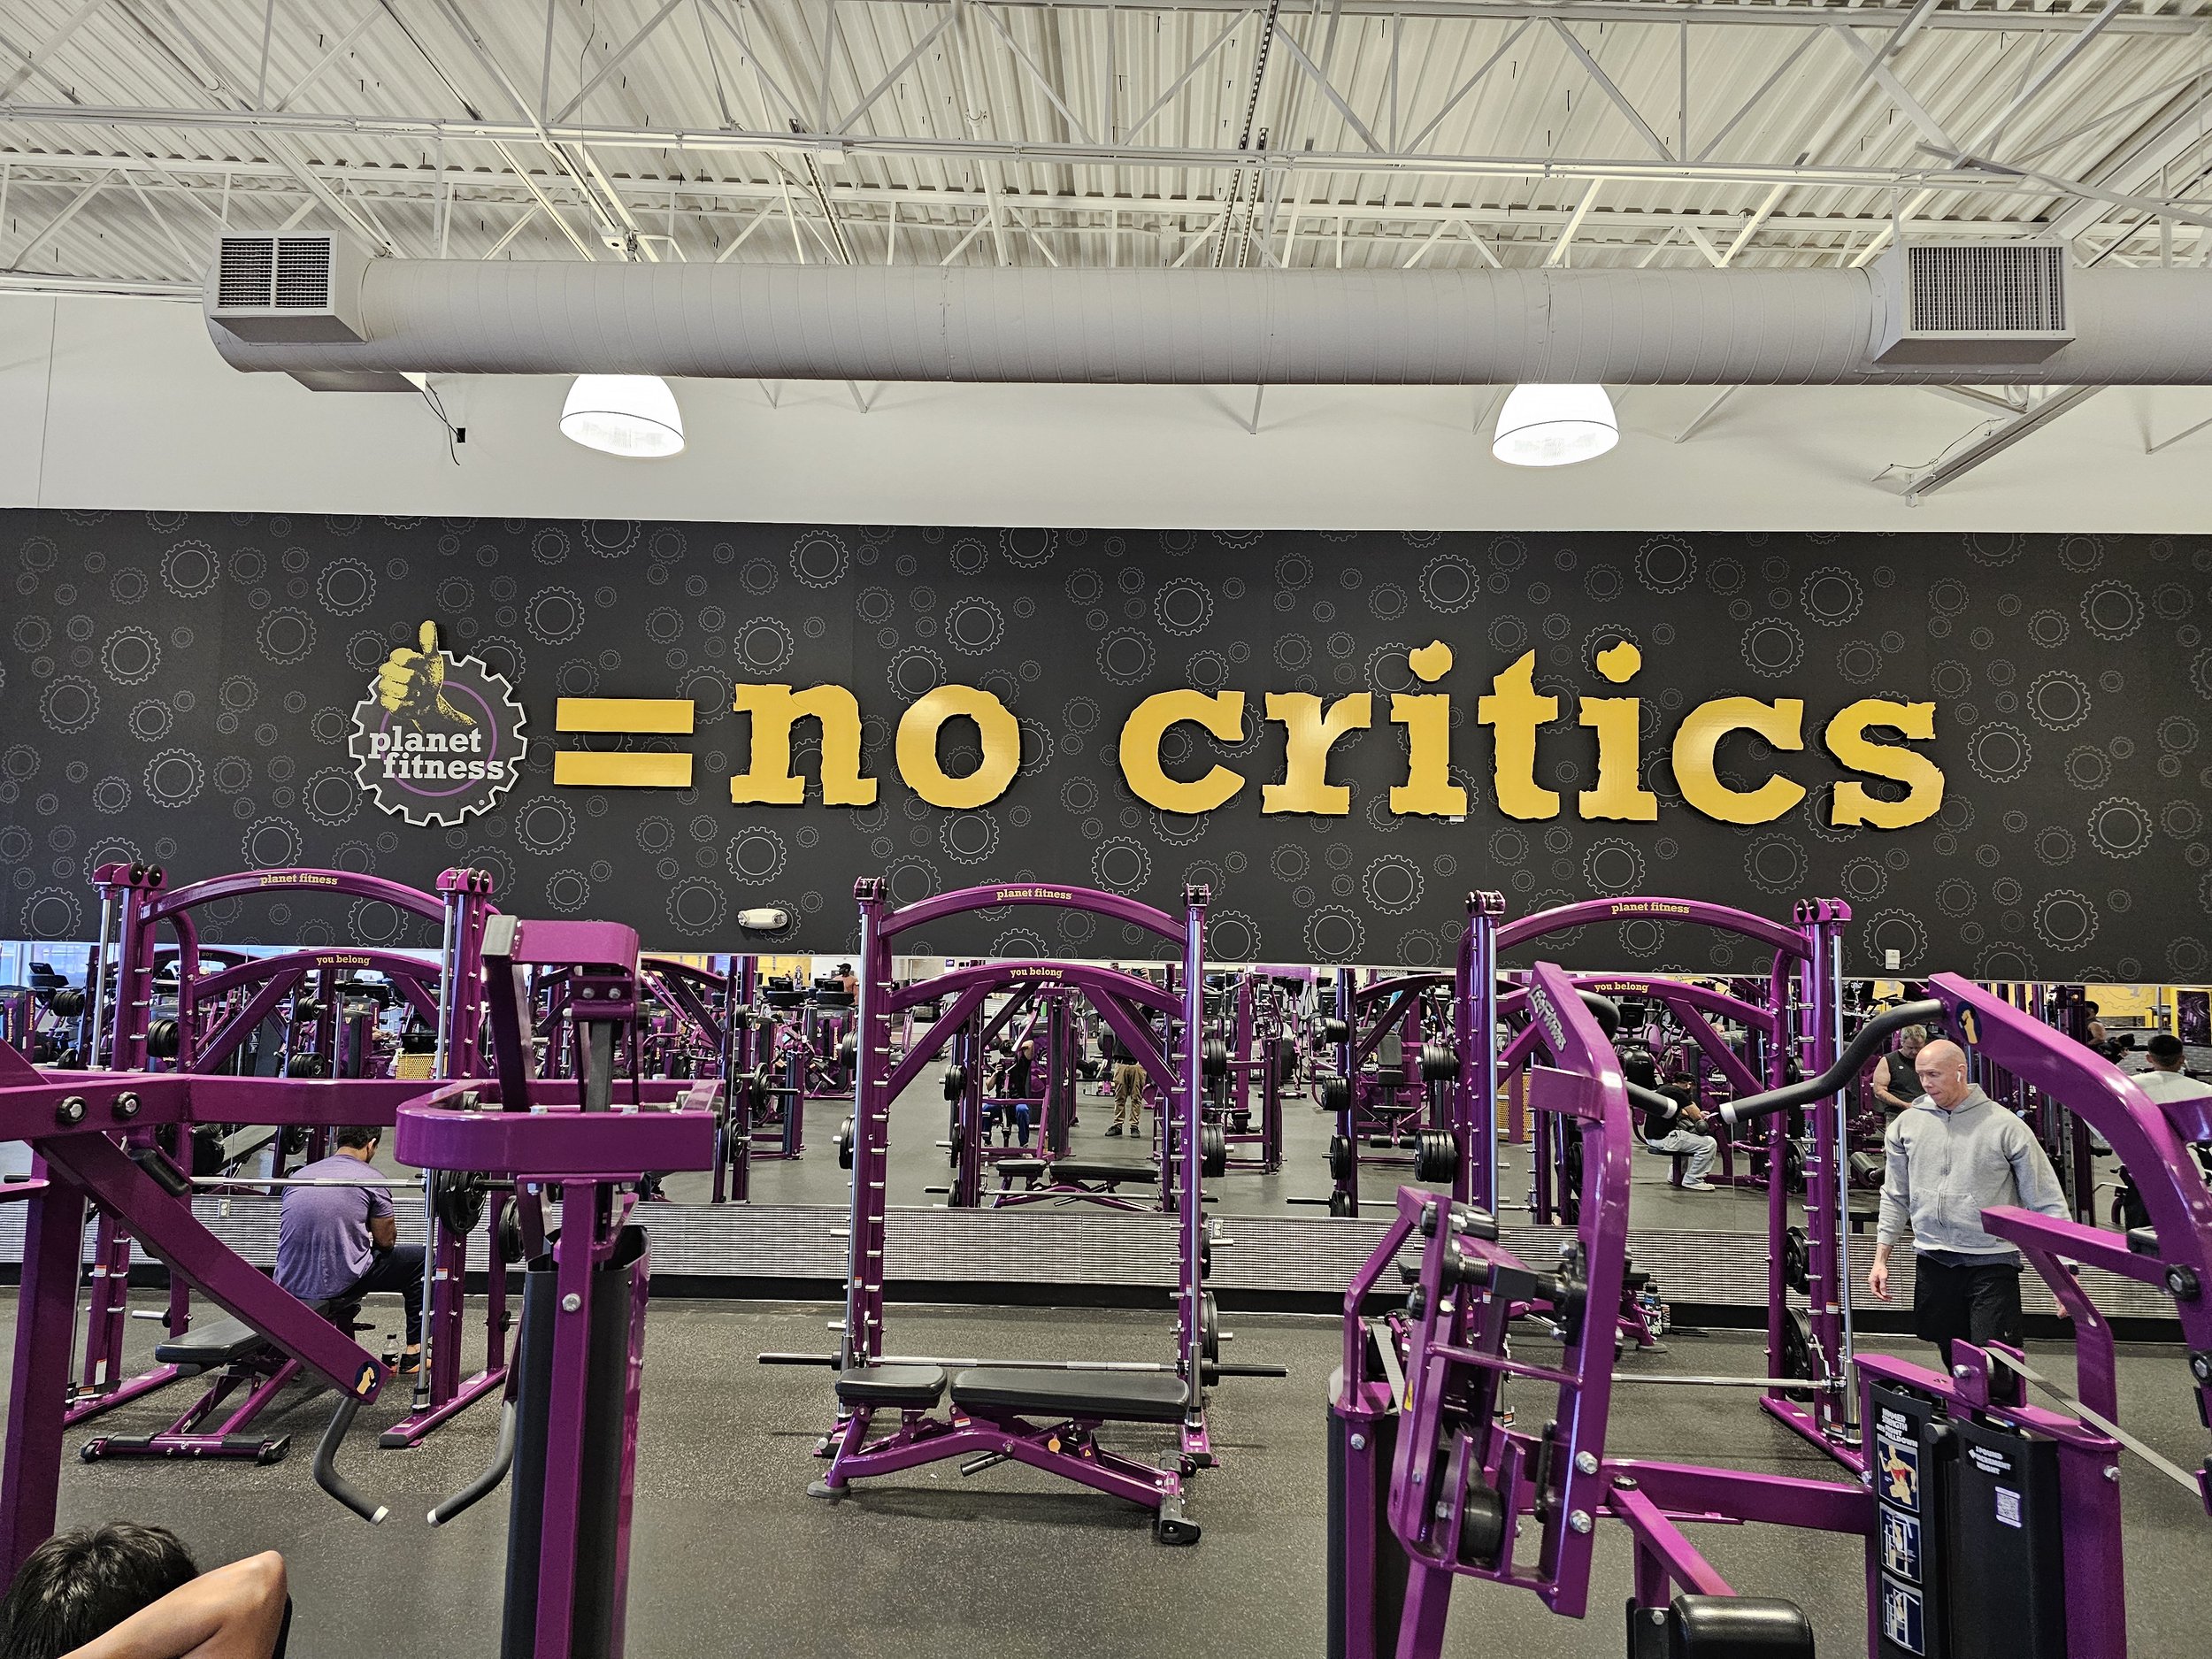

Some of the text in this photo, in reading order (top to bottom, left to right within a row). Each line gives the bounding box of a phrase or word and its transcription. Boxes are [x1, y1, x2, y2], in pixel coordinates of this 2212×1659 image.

[730, 684, 1021, 809] no
[1119, 640, 1945, 829] critics
[368, 726, 481, 759] planet
[383, 752, 504, 780] fitness
[260, 873, 339, 886] planet fitness
[996, 888, 1072, 901] planet fitness
[1611, 902, 1691, 915] planet fitness
[316, 955, 371, 966] you belong
[1010, 967, 1064, 979] you belong
[1594, 982, 1649, 994] you belong
